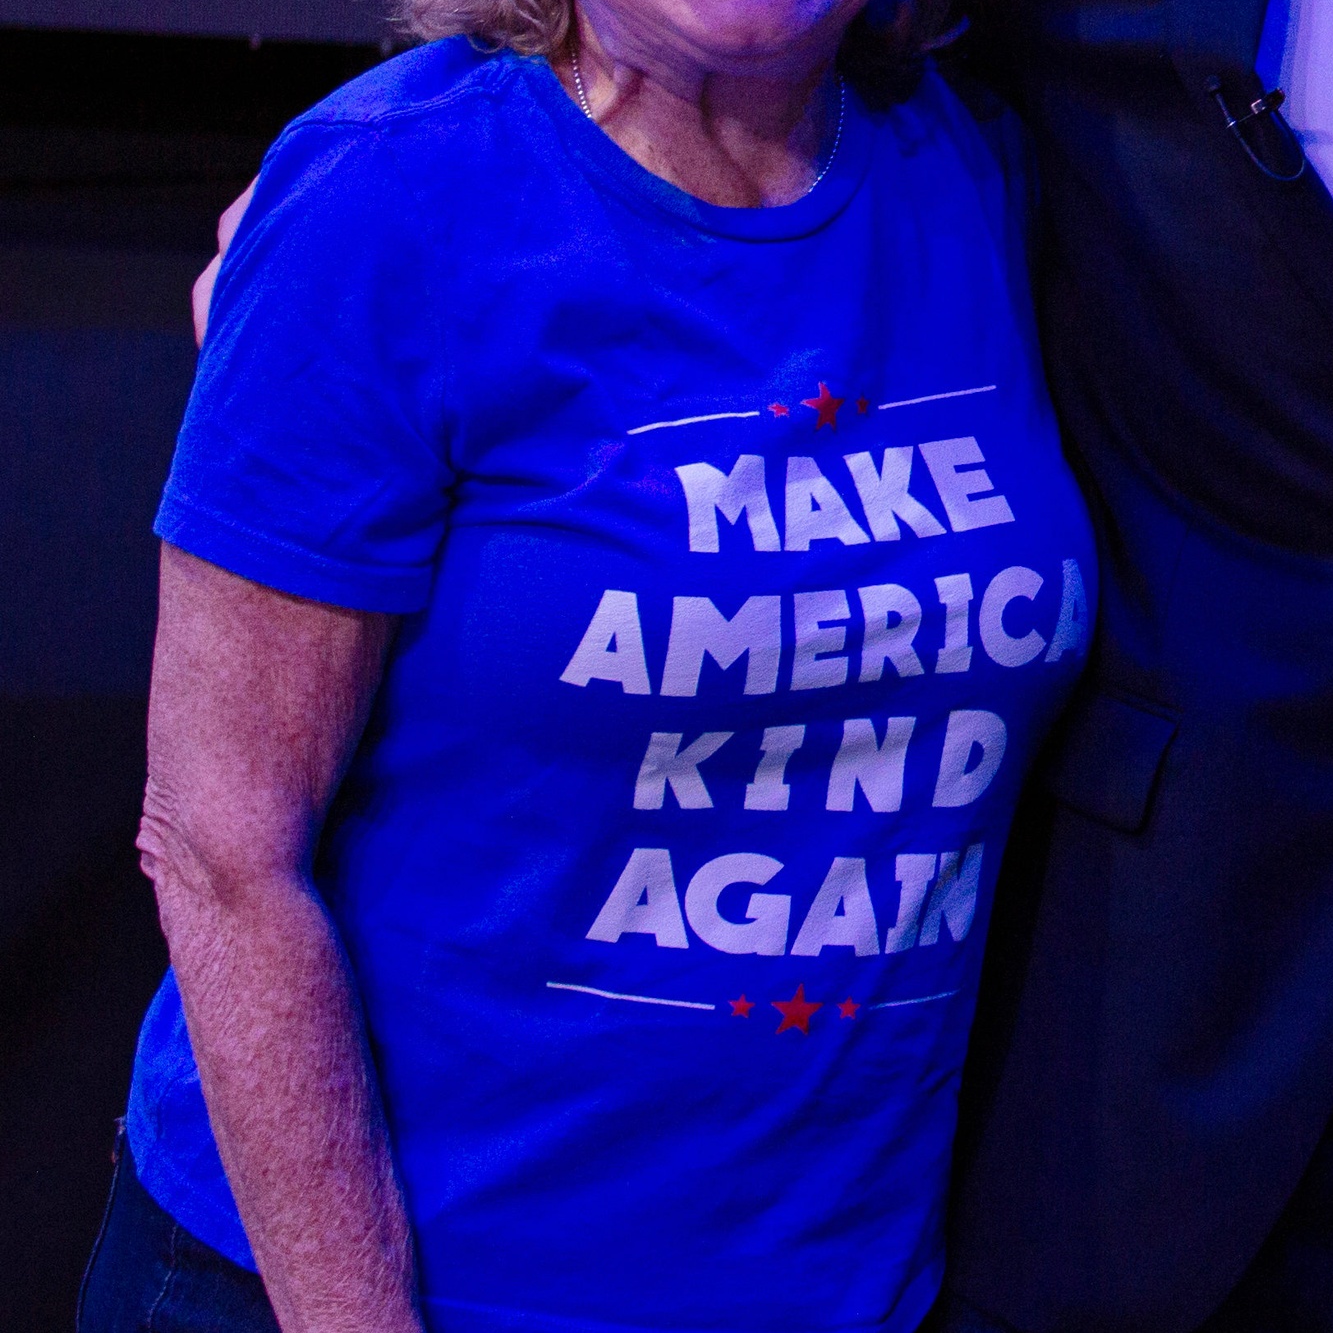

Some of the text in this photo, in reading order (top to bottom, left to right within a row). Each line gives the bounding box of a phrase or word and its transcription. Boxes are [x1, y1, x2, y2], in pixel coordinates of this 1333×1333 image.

[675, 436, 1016, 553] MAKE
[559, 559, 1088, 697] AMERICA
[632, 709, 1009, 813] KIND
[585, 843, 985, 958] AGAIN
